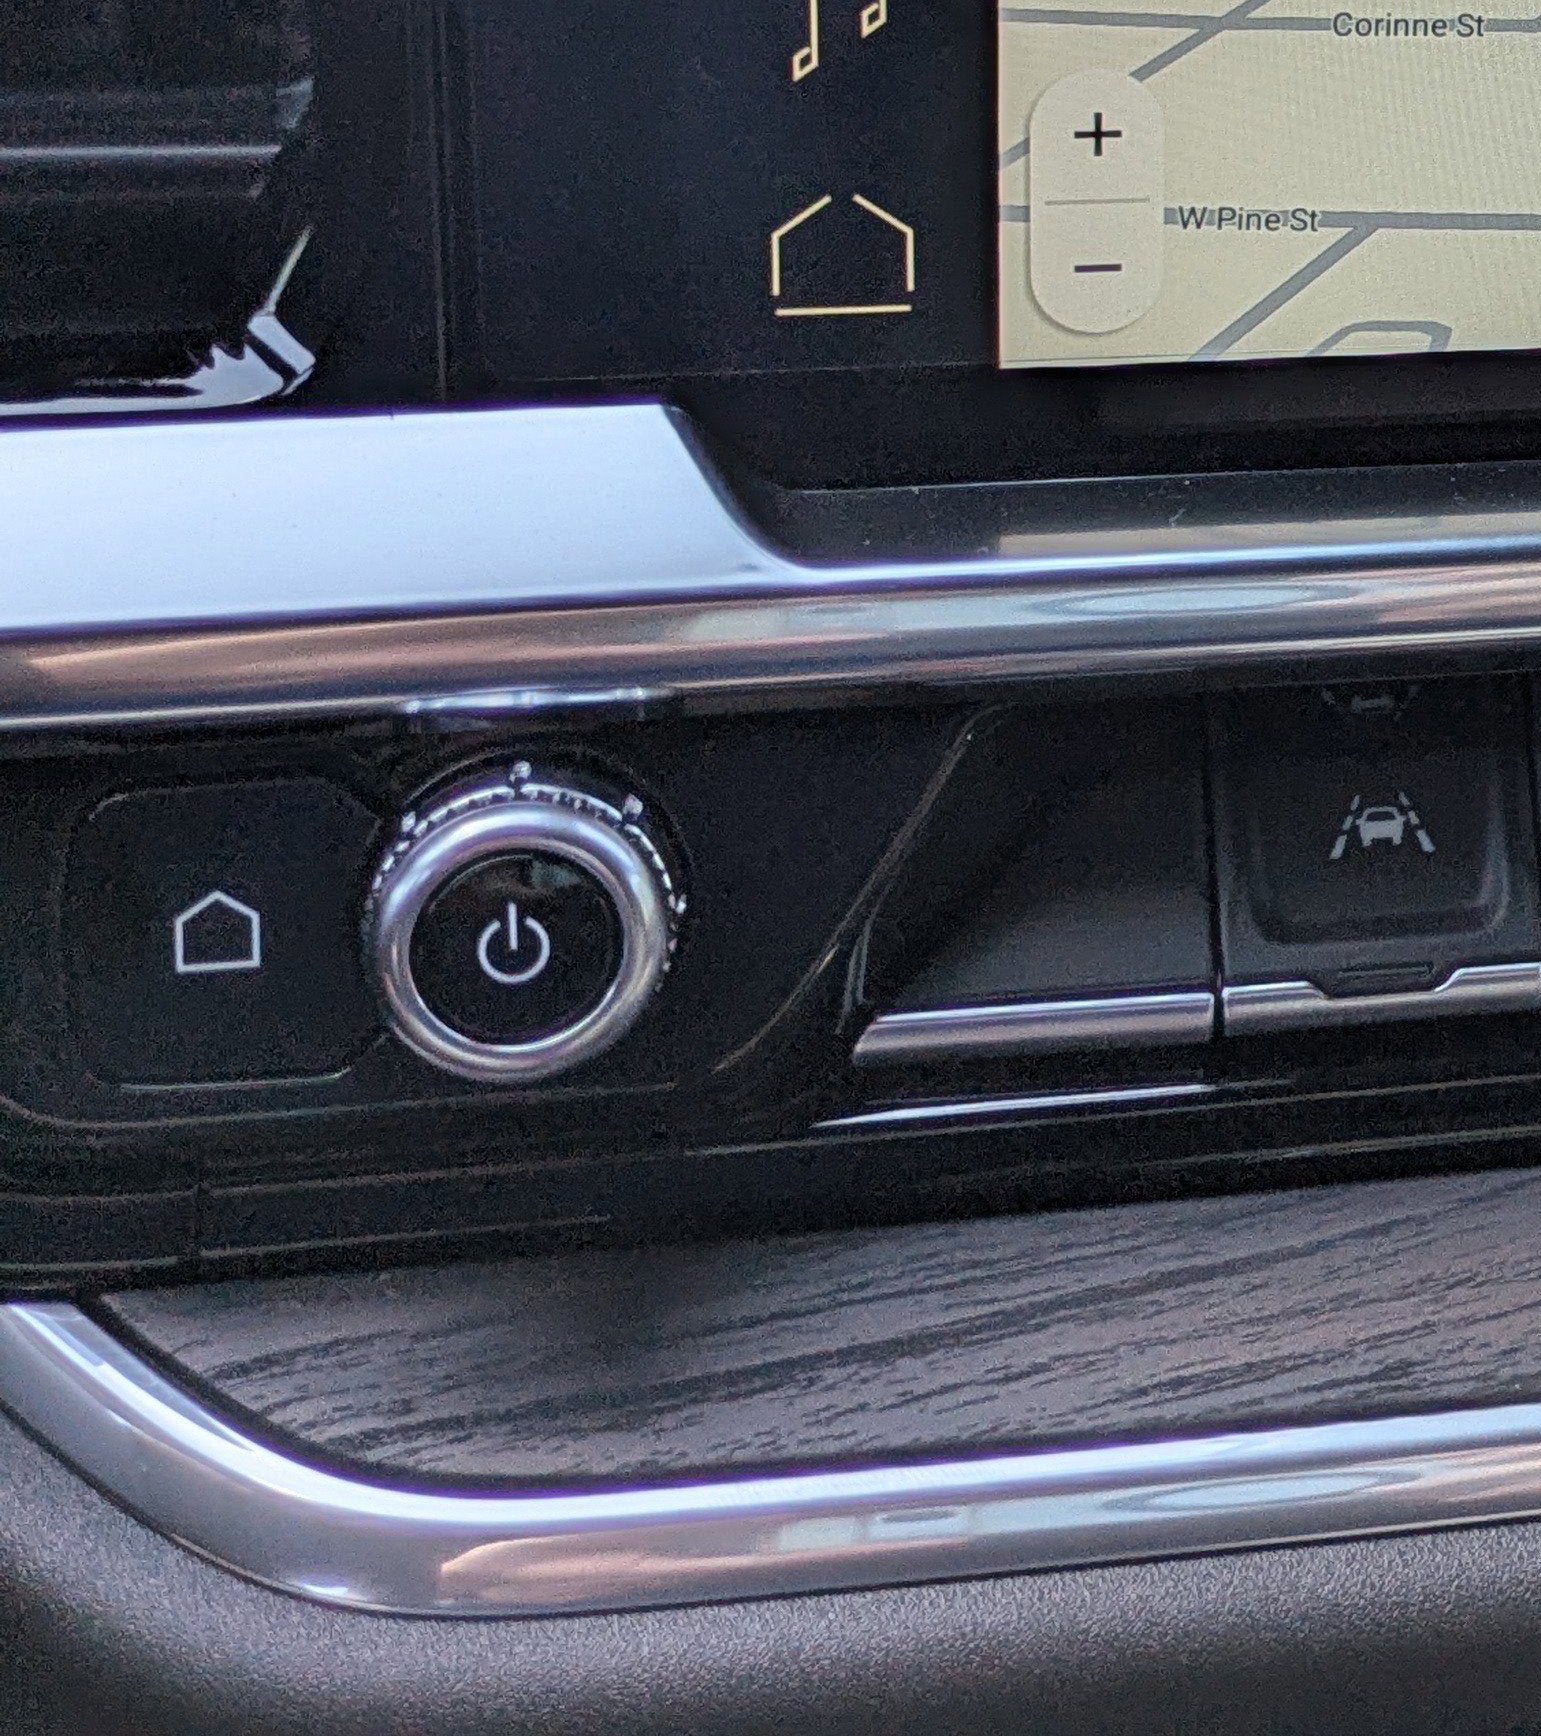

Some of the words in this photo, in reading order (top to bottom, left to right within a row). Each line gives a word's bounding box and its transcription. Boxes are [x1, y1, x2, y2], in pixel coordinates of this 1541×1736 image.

[1332, 13, 1449, 39] Corinne
[1455, 14, 1485, 38] St
[1178, 206, 1209, 230] W
[1216, 206, 1282, 232] Pine
[1289, 208, 1318, 232] St
